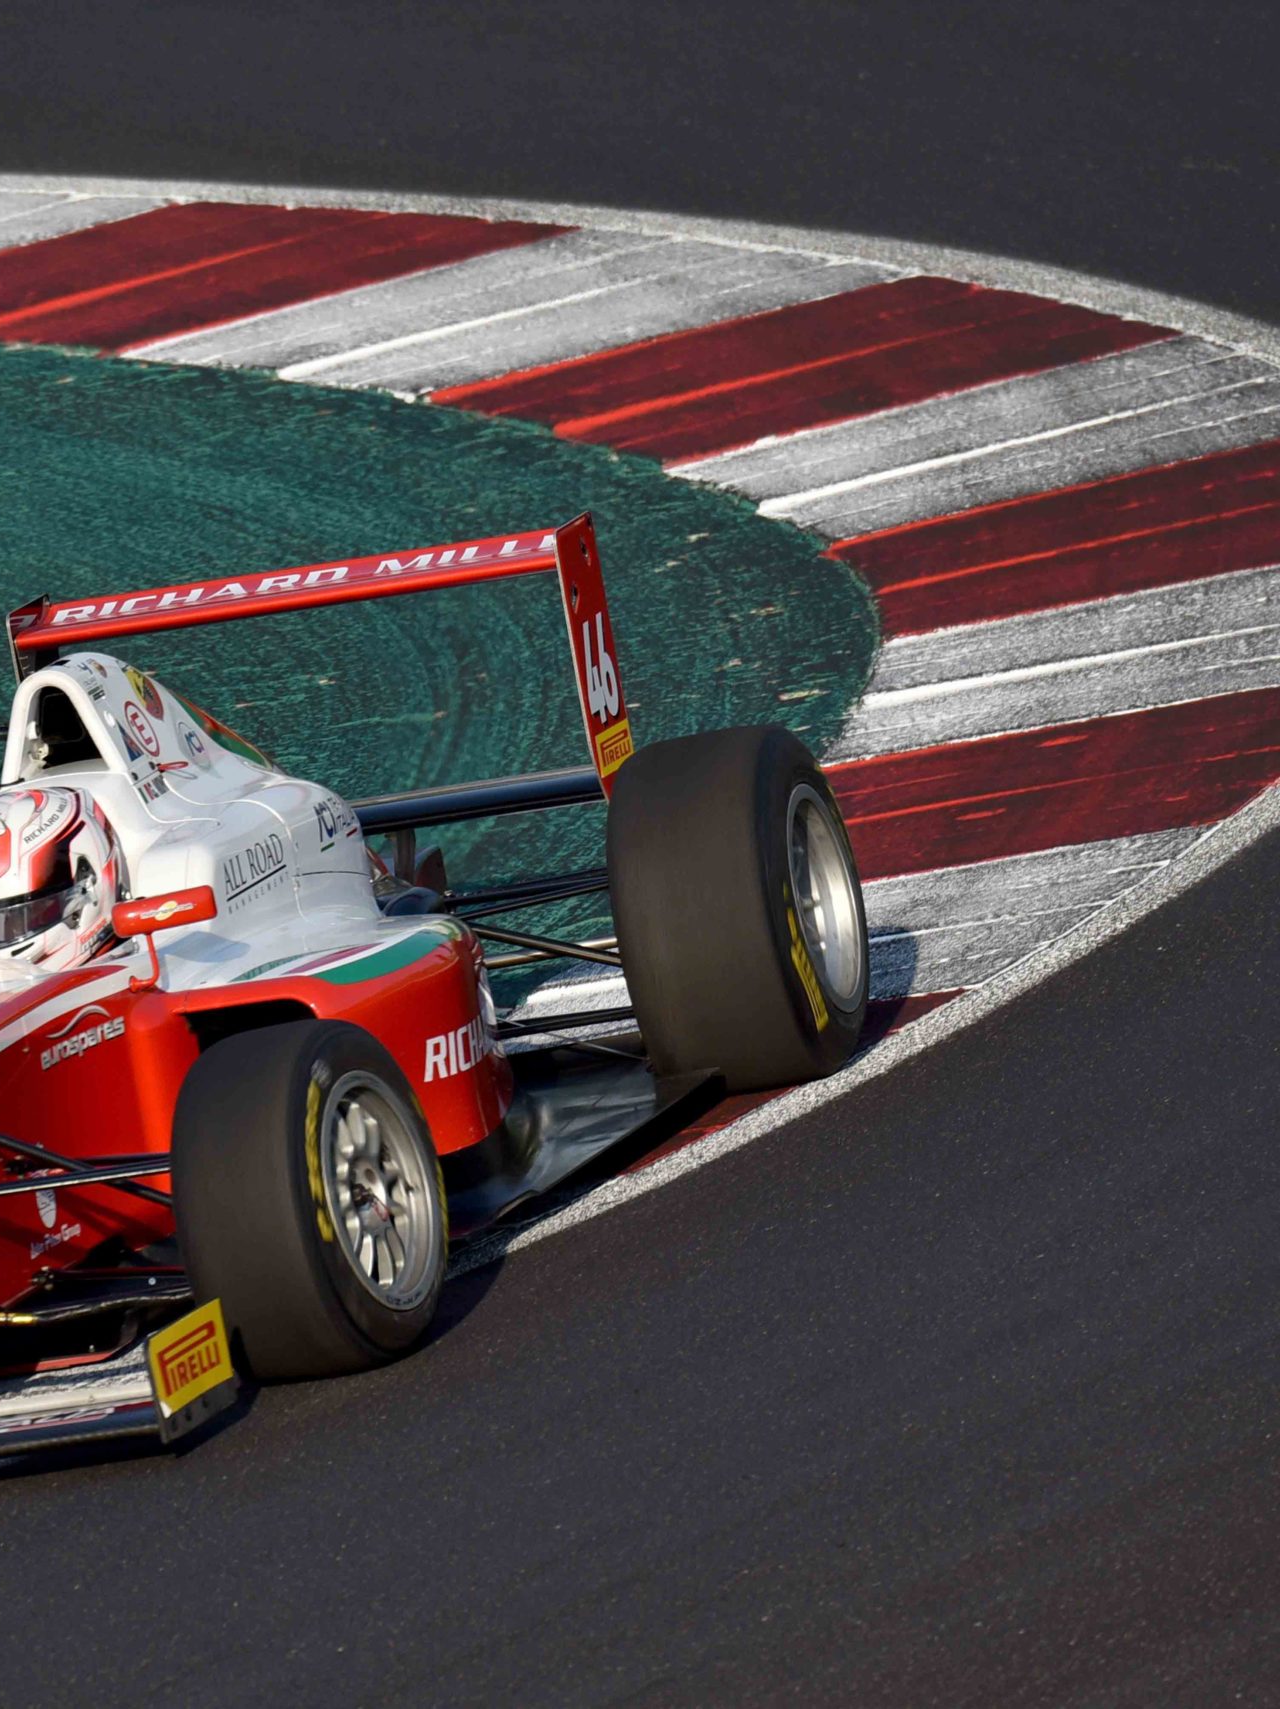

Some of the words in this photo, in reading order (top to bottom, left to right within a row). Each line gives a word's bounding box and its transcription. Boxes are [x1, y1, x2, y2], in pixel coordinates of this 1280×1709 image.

[51, 567, 350, 625] RICHARD
[582, 611, 620, 724] 46
[600, 728, 631, 768] PIRELLI
[23, 813, 60, 844] RICHARD
[223, 855, 248, 896] ALL
[245, 833, 284, 880] ROAD
[40, 1016, 125, 1070] eurospares
[157, 1320, 222, 1398] PIRELLI
